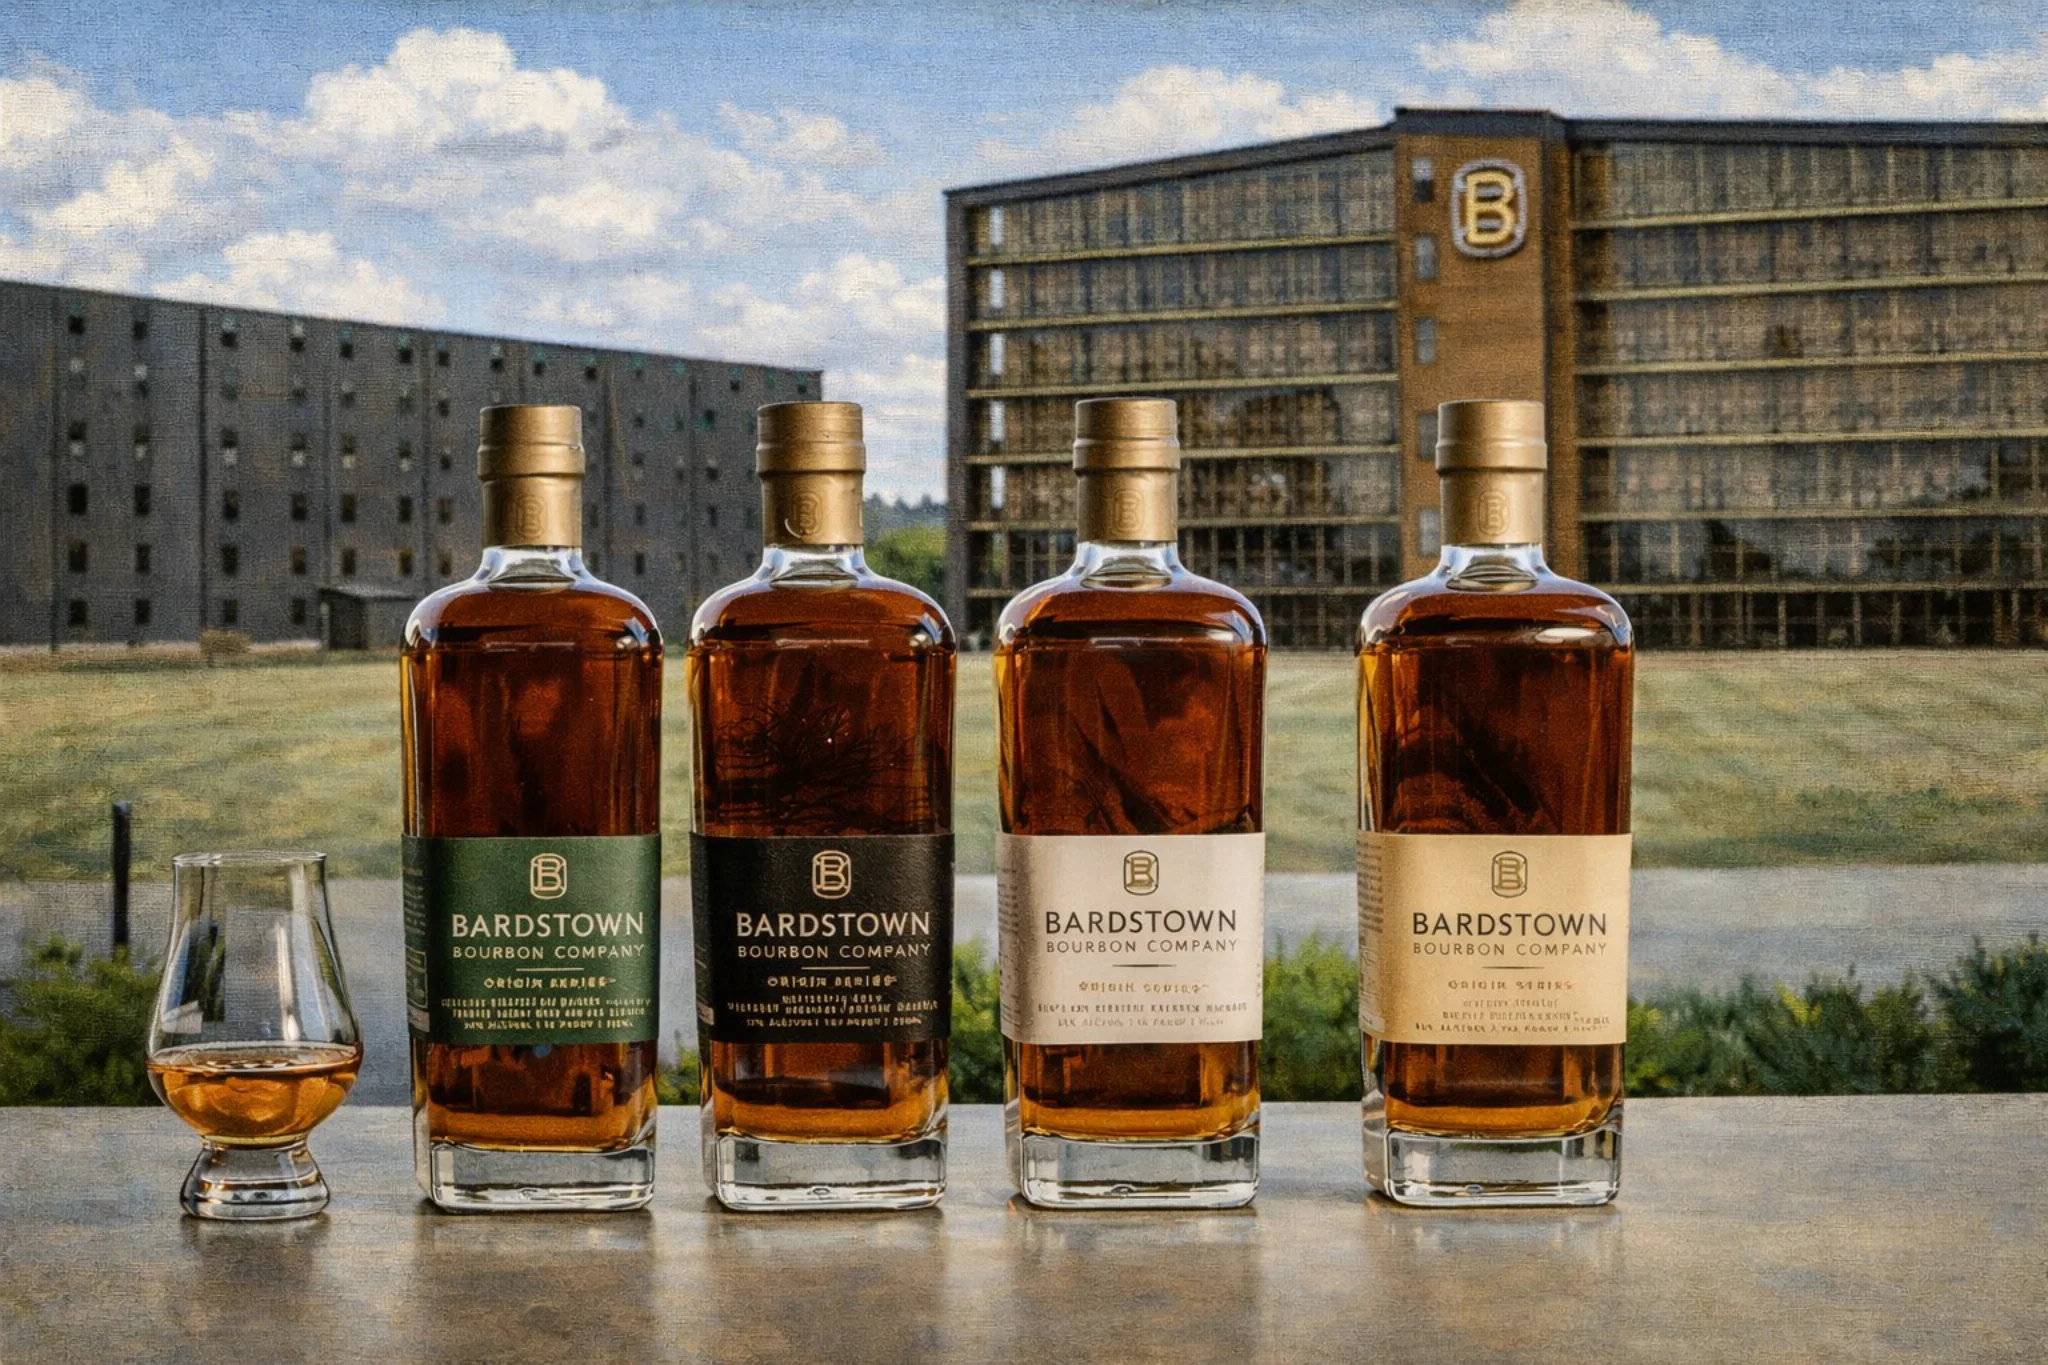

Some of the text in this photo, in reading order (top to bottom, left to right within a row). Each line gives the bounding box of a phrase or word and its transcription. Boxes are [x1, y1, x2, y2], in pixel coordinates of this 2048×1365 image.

[1466, 171, 1515, 244] B
[535, 857, 563, 893] B
[818, 854, 847, 892] B
[1128, 854, 1155, 889] B
[1498, 856, 1525, 891] B
[452, 911, 644, 938] BARDSTOWN
[736, 911, 931, 937] BARDSTOWN
[1045, 909, 1237, 935] BARDSTOWN
[1412, 912, 1607, 937] BARDSTOWN
[452, 944, 645, 960] BOURBON COMPANY
[737, 943, 932, 959] BOURBON COMPANY
[1046, 939, 1238, 953] BOURBON COMPANY
[1412, 942, 1607, 957] BOURBON COMPANY
